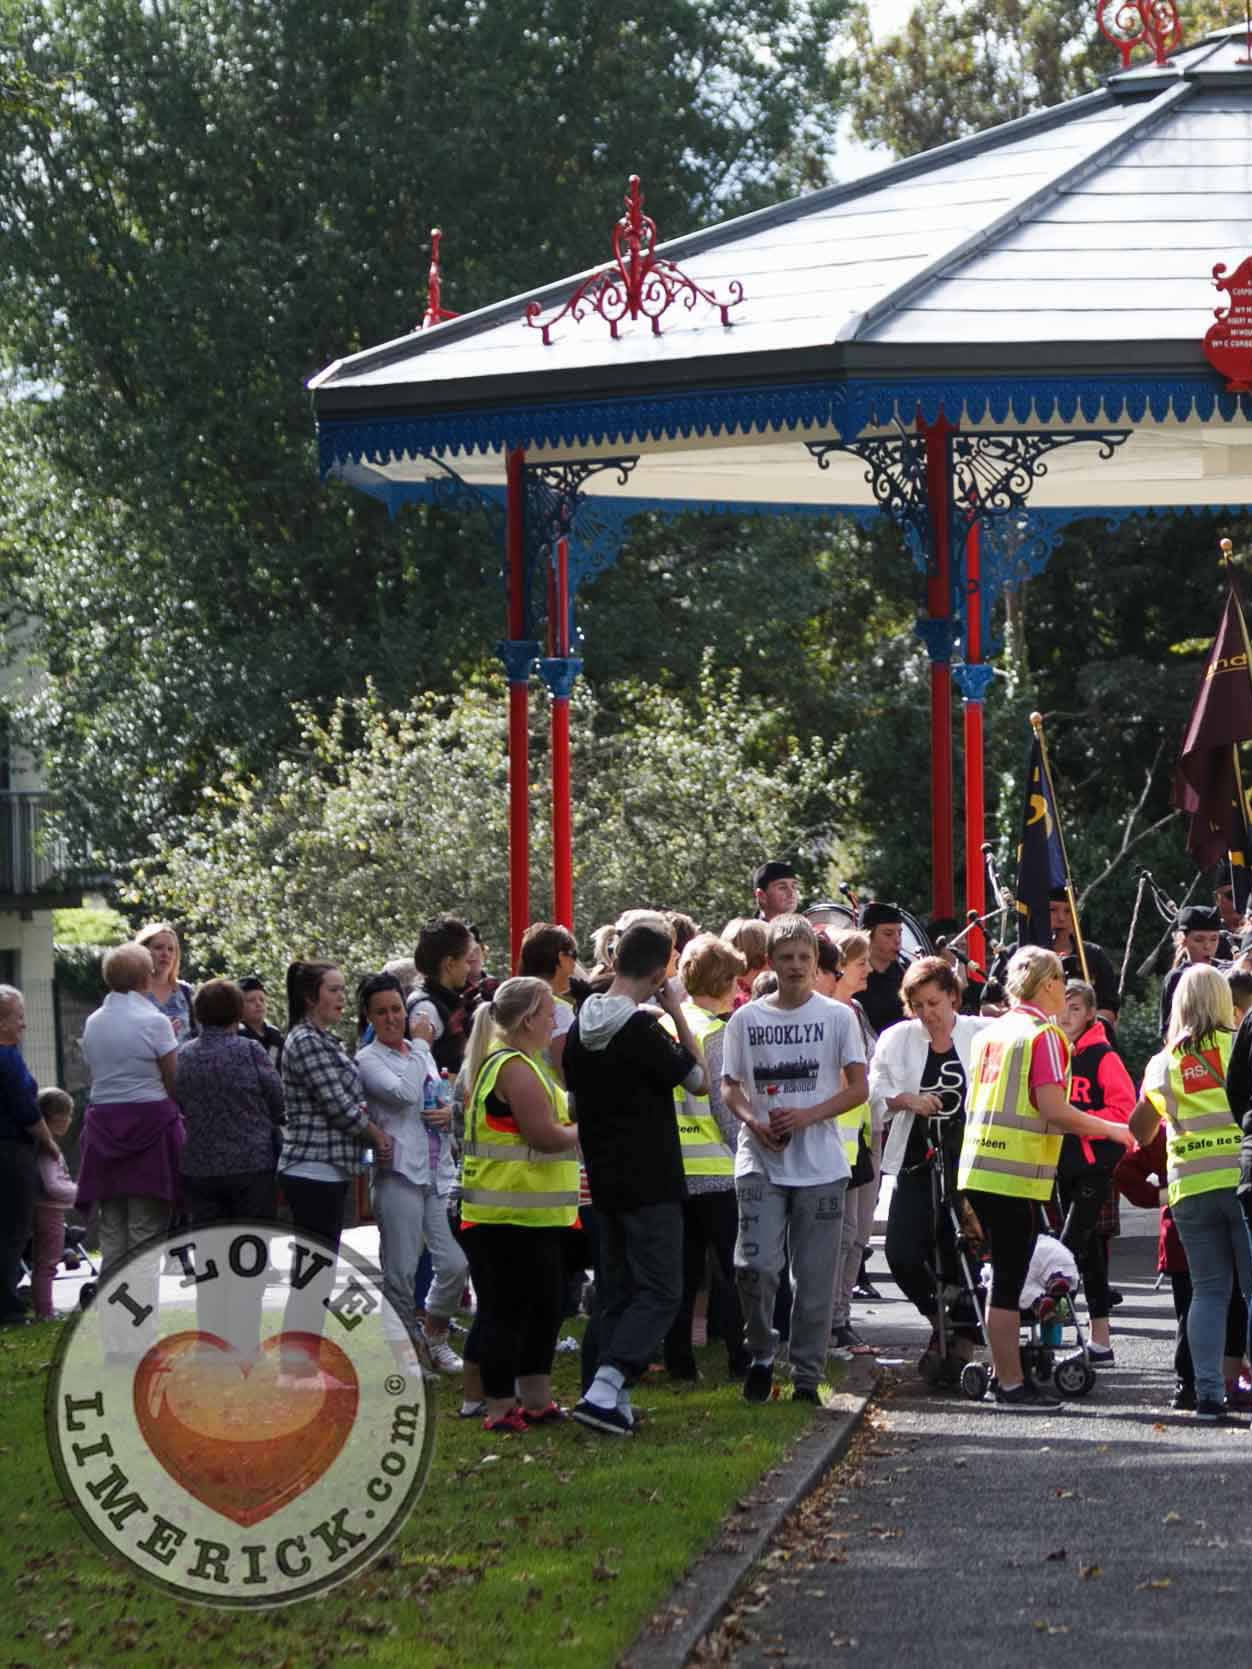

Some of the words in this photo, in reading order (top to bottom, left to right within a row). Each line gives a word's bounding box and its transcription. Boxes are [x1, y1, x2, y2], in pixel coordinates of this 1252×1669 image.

[748, 1022, 824, 1047] BROOKLYN
[678, 1125, 700, 1135] een
[1187, 1138, 1213, 1152] Safe
